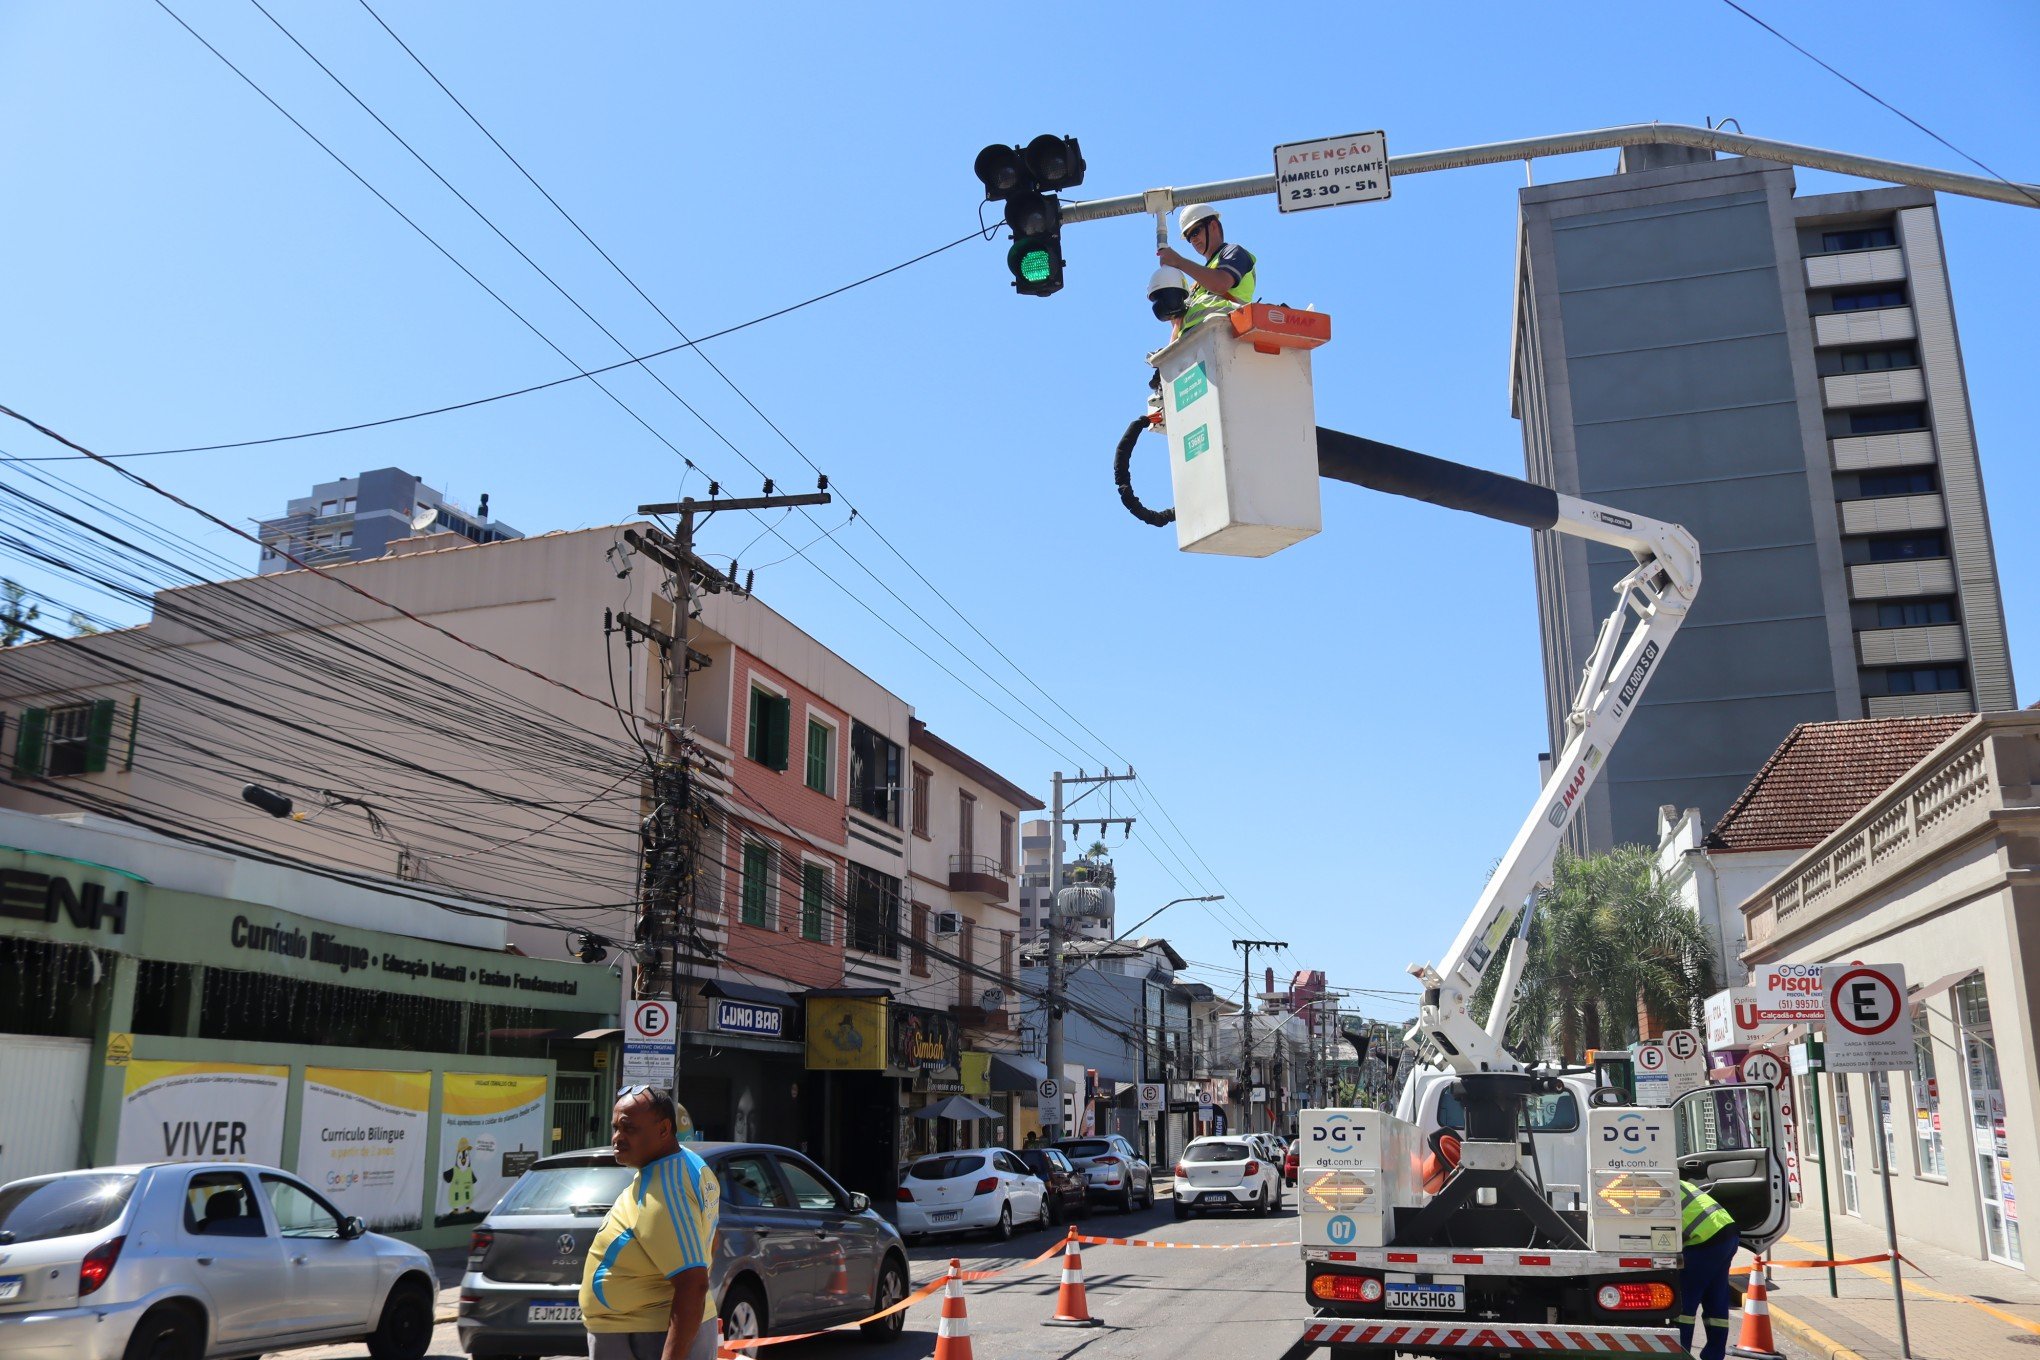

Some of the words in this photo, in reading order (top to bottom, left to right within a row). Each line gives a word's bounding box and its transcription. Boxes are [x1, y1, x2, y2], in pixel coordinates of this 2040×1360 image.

[1288, 143, 1371, 164] ATENÇÃO
[1281, 169, 1328, 183] AMARELO
[1335, 161, 1383, 175] PISCANTE
[1291, 184, 1340, 200] 23:30
[1356, 180, 1377, 190] 5h
[1622, 666, 1645, 700] 10.000
[1640, 657, 1650, 668] S
[1562, 765, 1585, 808] IMAP
[231, 915, 307, 959] Currículo
[310, 931, 369, 973] Bilíngue
[382, 953, 428, 980] Educação
[431, 962, 466, 982] Infantil
[479, 969, 511, 988] Ensino
[514, 973, 577, 995] Fundamental
[1769, 974, 1823, 995] Pisqu
[1779, 1000, 1792, 1010] (51)
[1852, 983, 1879, 1021] E
[646, 1010, 657, 1029] E
[722, 1006, 752, 1027] LUNA
[756, 1011, 778, 1030] BAR
[1735, 1004, 1759, 1030] U
[1760, 1012, 1794, 1020] Calçadão
[914, 1032, 944, 1060] Simbah
[1676, 1036, 1689, 1054] E
[1647, 1052, 1656, 1064] E
[1747, 1062, 1778, 1080] 40
[1045, 1084, 1052, 1095] E
[163, 1122, 246, 1156] VIVER
[322, 1126, 365, 1142] Currículo
[368, 1126, 404, 1144] Bilíngue
[1314, 1127, 1365, 1141] DGT
[1604, 1127, 1660, 1141] DGT
[1782, 1103, 1798, 1182] ÓTICA
[1317, 1158, 1362, 1168] dgt.com.br
[1608, 1160, 1658, 1168] dgt.com.br
[327, 1169, 359, 1188] Google
[1332, 1221, 1350, 1238] 07
[1393, 1292, 1456, 1307] JCK5H08
[534, 1306, 582, 1322] EJM2I82
